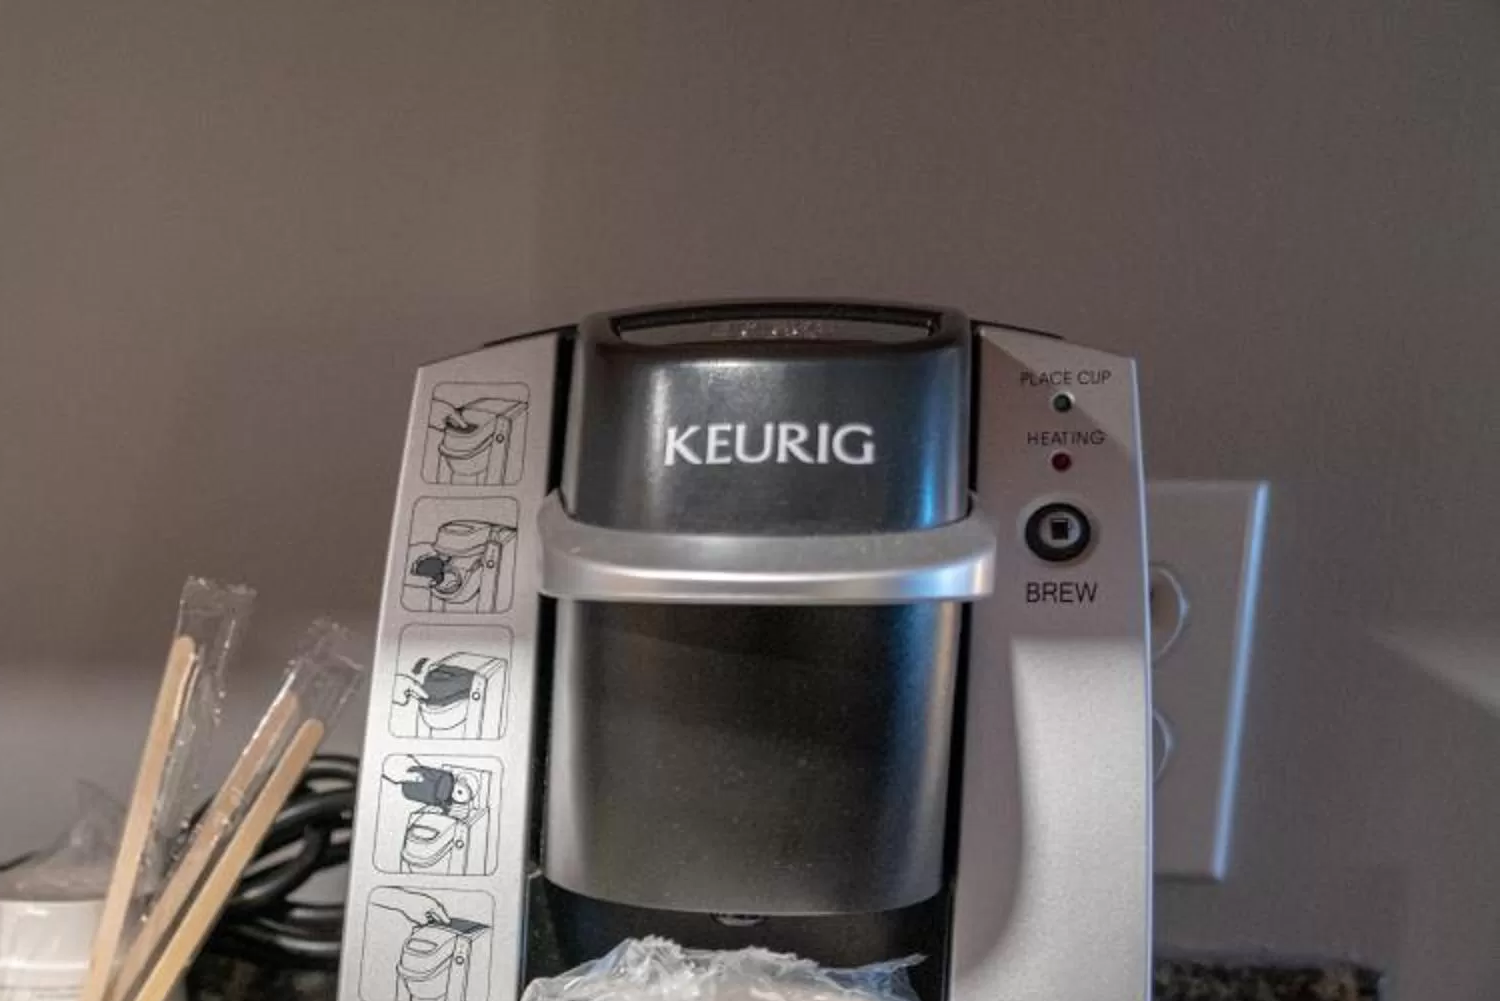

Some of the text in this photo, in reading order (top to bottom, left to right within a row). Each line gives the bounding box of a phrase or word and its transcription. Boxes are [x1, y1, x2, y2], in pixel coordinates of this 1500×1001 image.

[1020, 369, 1113, 387] PLACE CUP
[663, 421, 876, 467] KEURIG
[1027, 428, 1109, 446] HEATING
[1026, 581, 1098, 604] BREW
